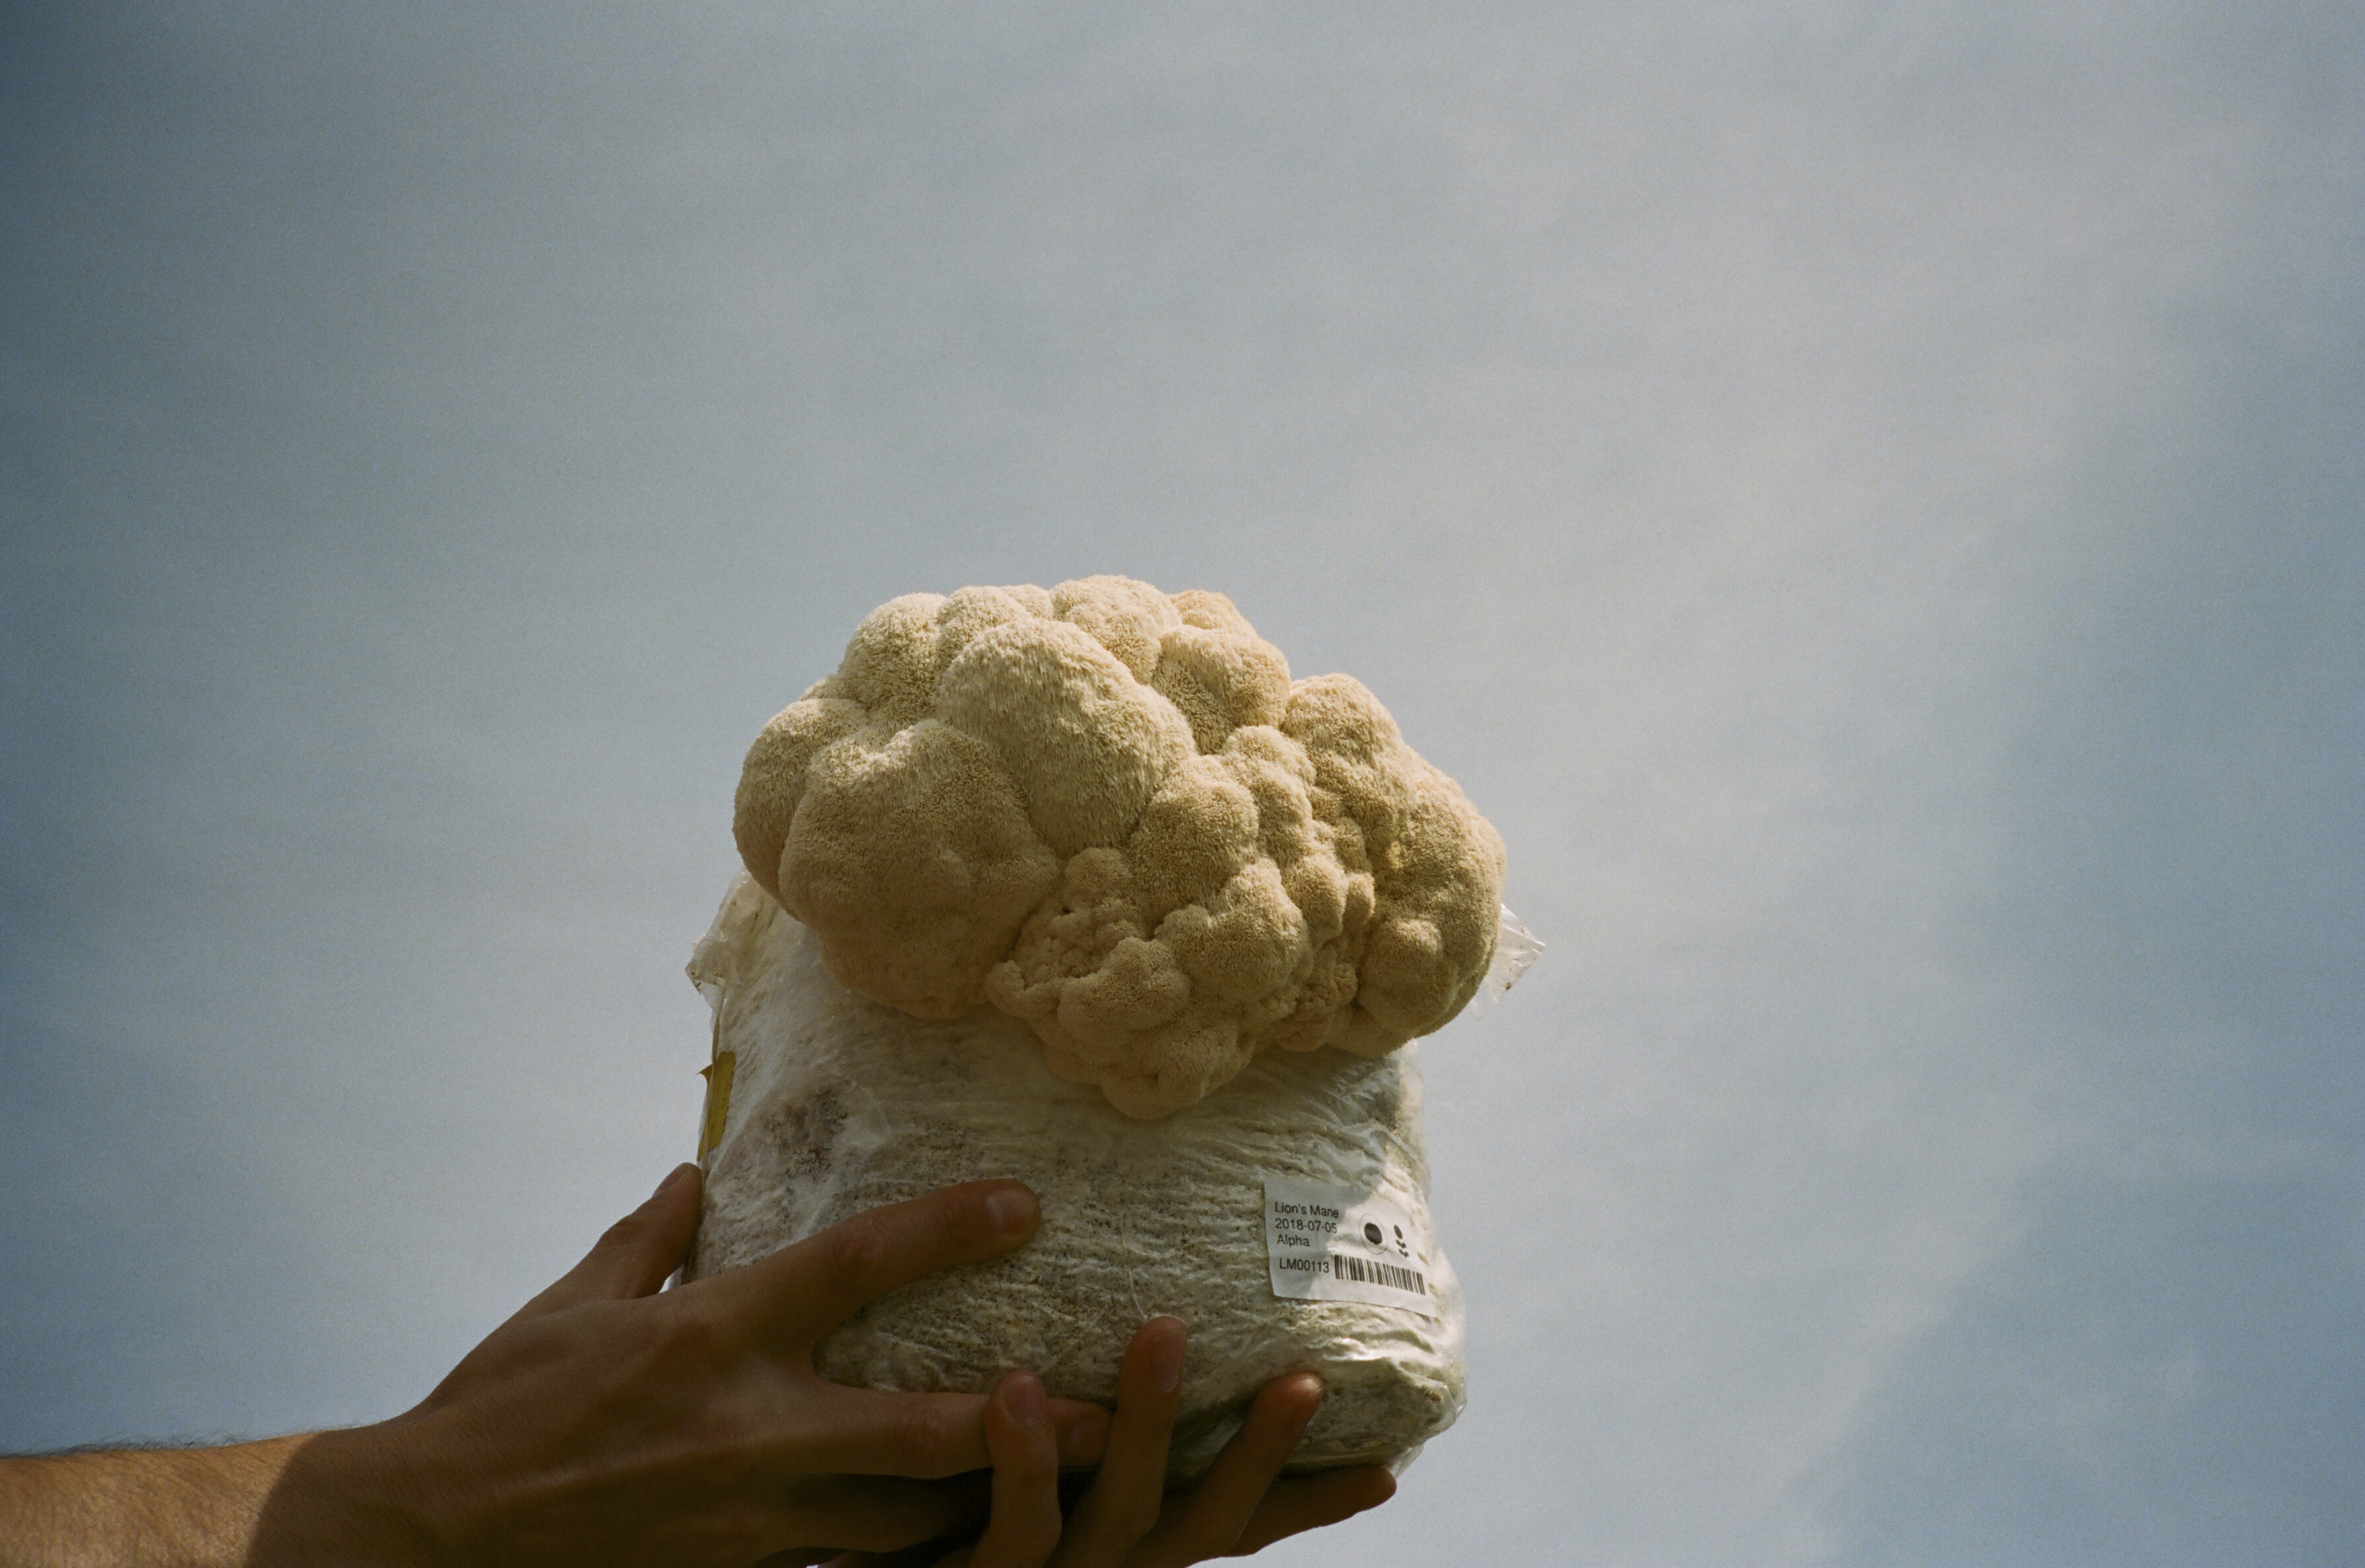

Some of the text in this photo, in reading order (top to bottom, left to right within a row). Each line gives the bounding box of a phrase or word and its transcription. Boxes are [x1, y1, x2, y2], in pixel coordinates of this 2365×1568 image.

[1275, 1201, 1339, 1219] Lion's Mane
[1275, 1218, 1337, 1234] 2018-07-05
[1277, 1233, 1310, 1247] Alpha
[1279, 1257, 1329, 1274] LM00113
